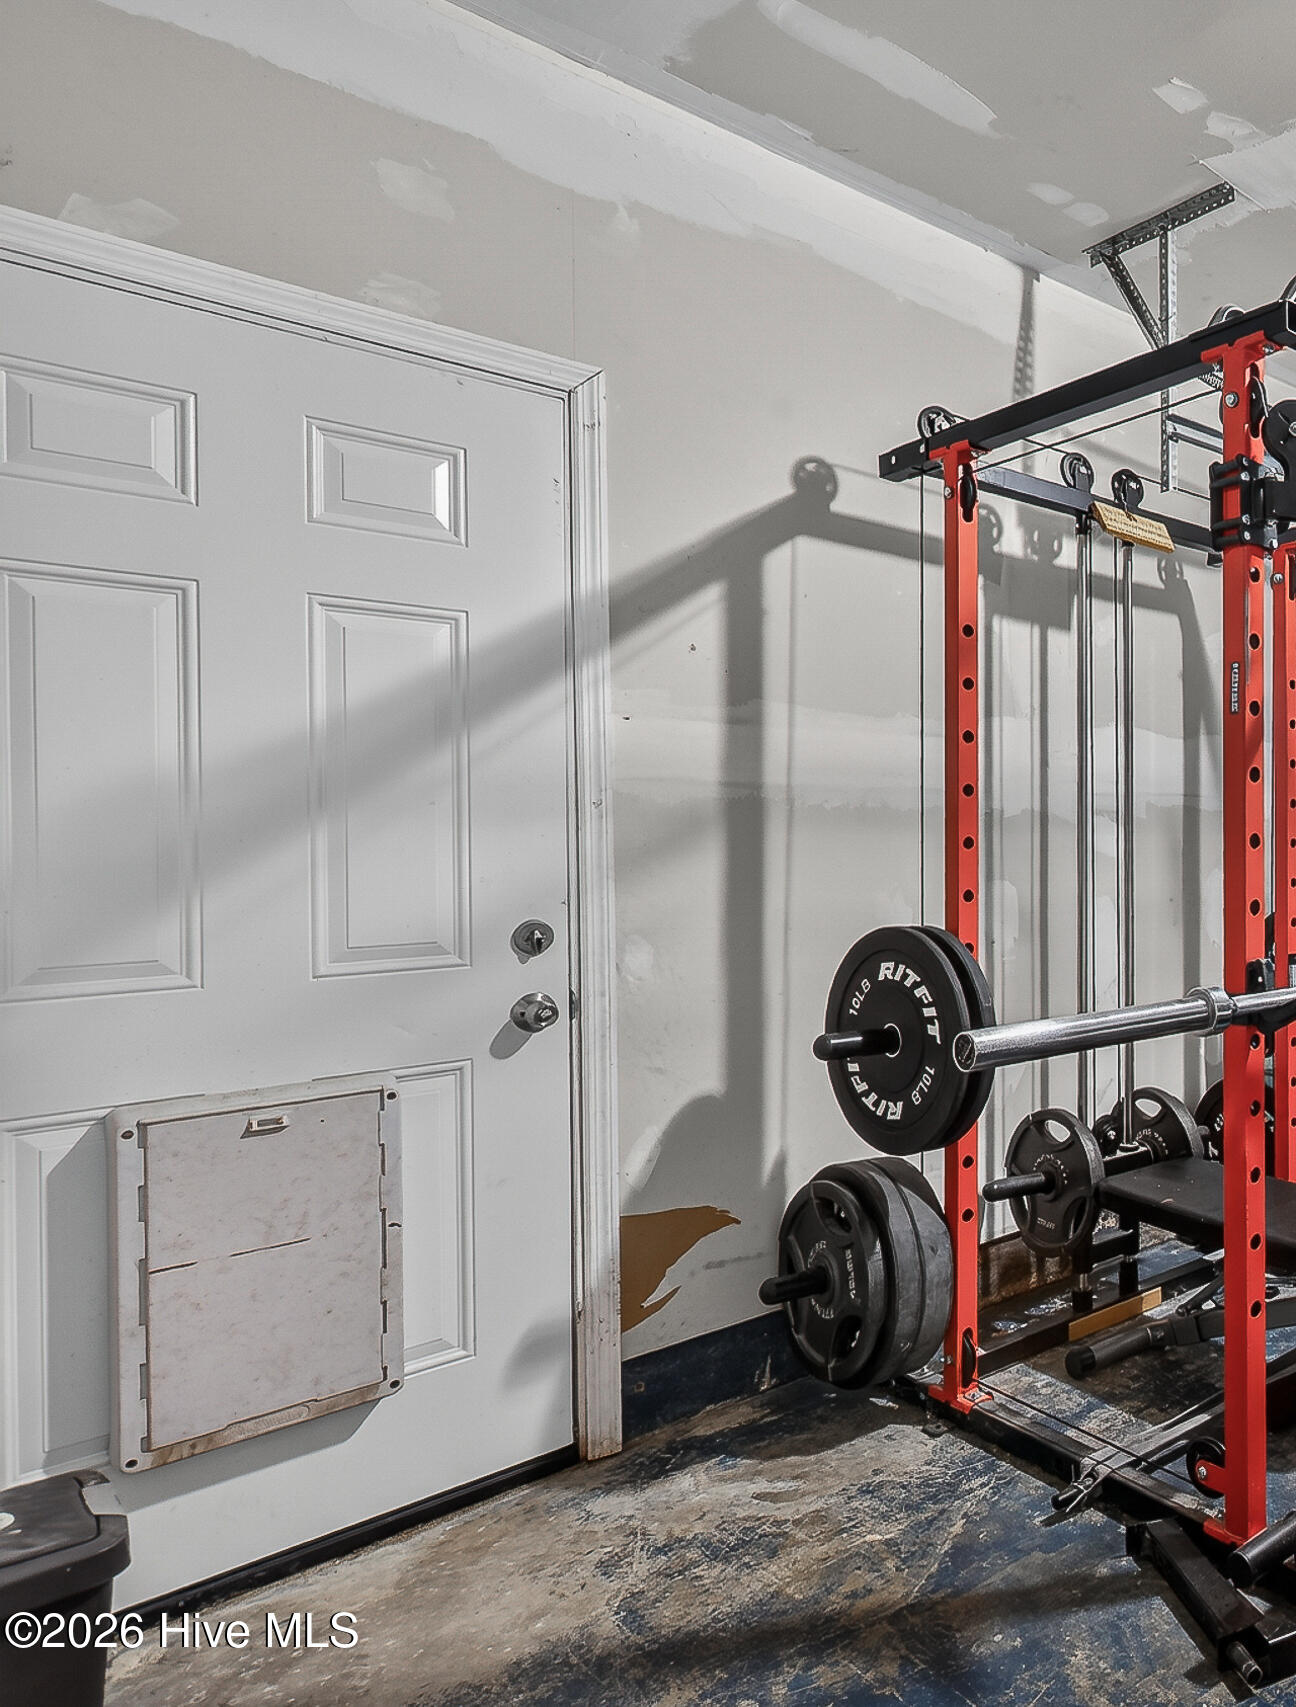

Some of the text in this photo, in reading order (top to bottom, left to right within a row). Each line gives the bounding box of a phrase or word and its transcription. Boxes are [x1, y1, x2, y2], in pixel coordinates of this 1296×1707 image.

[849, 978, 871, 1015] 10LB
[878, 961, 941, 1044] RITFIT
[847, 1057, 903, 1120] RITFI
[911, 1065, 935, 1104] 10LB
